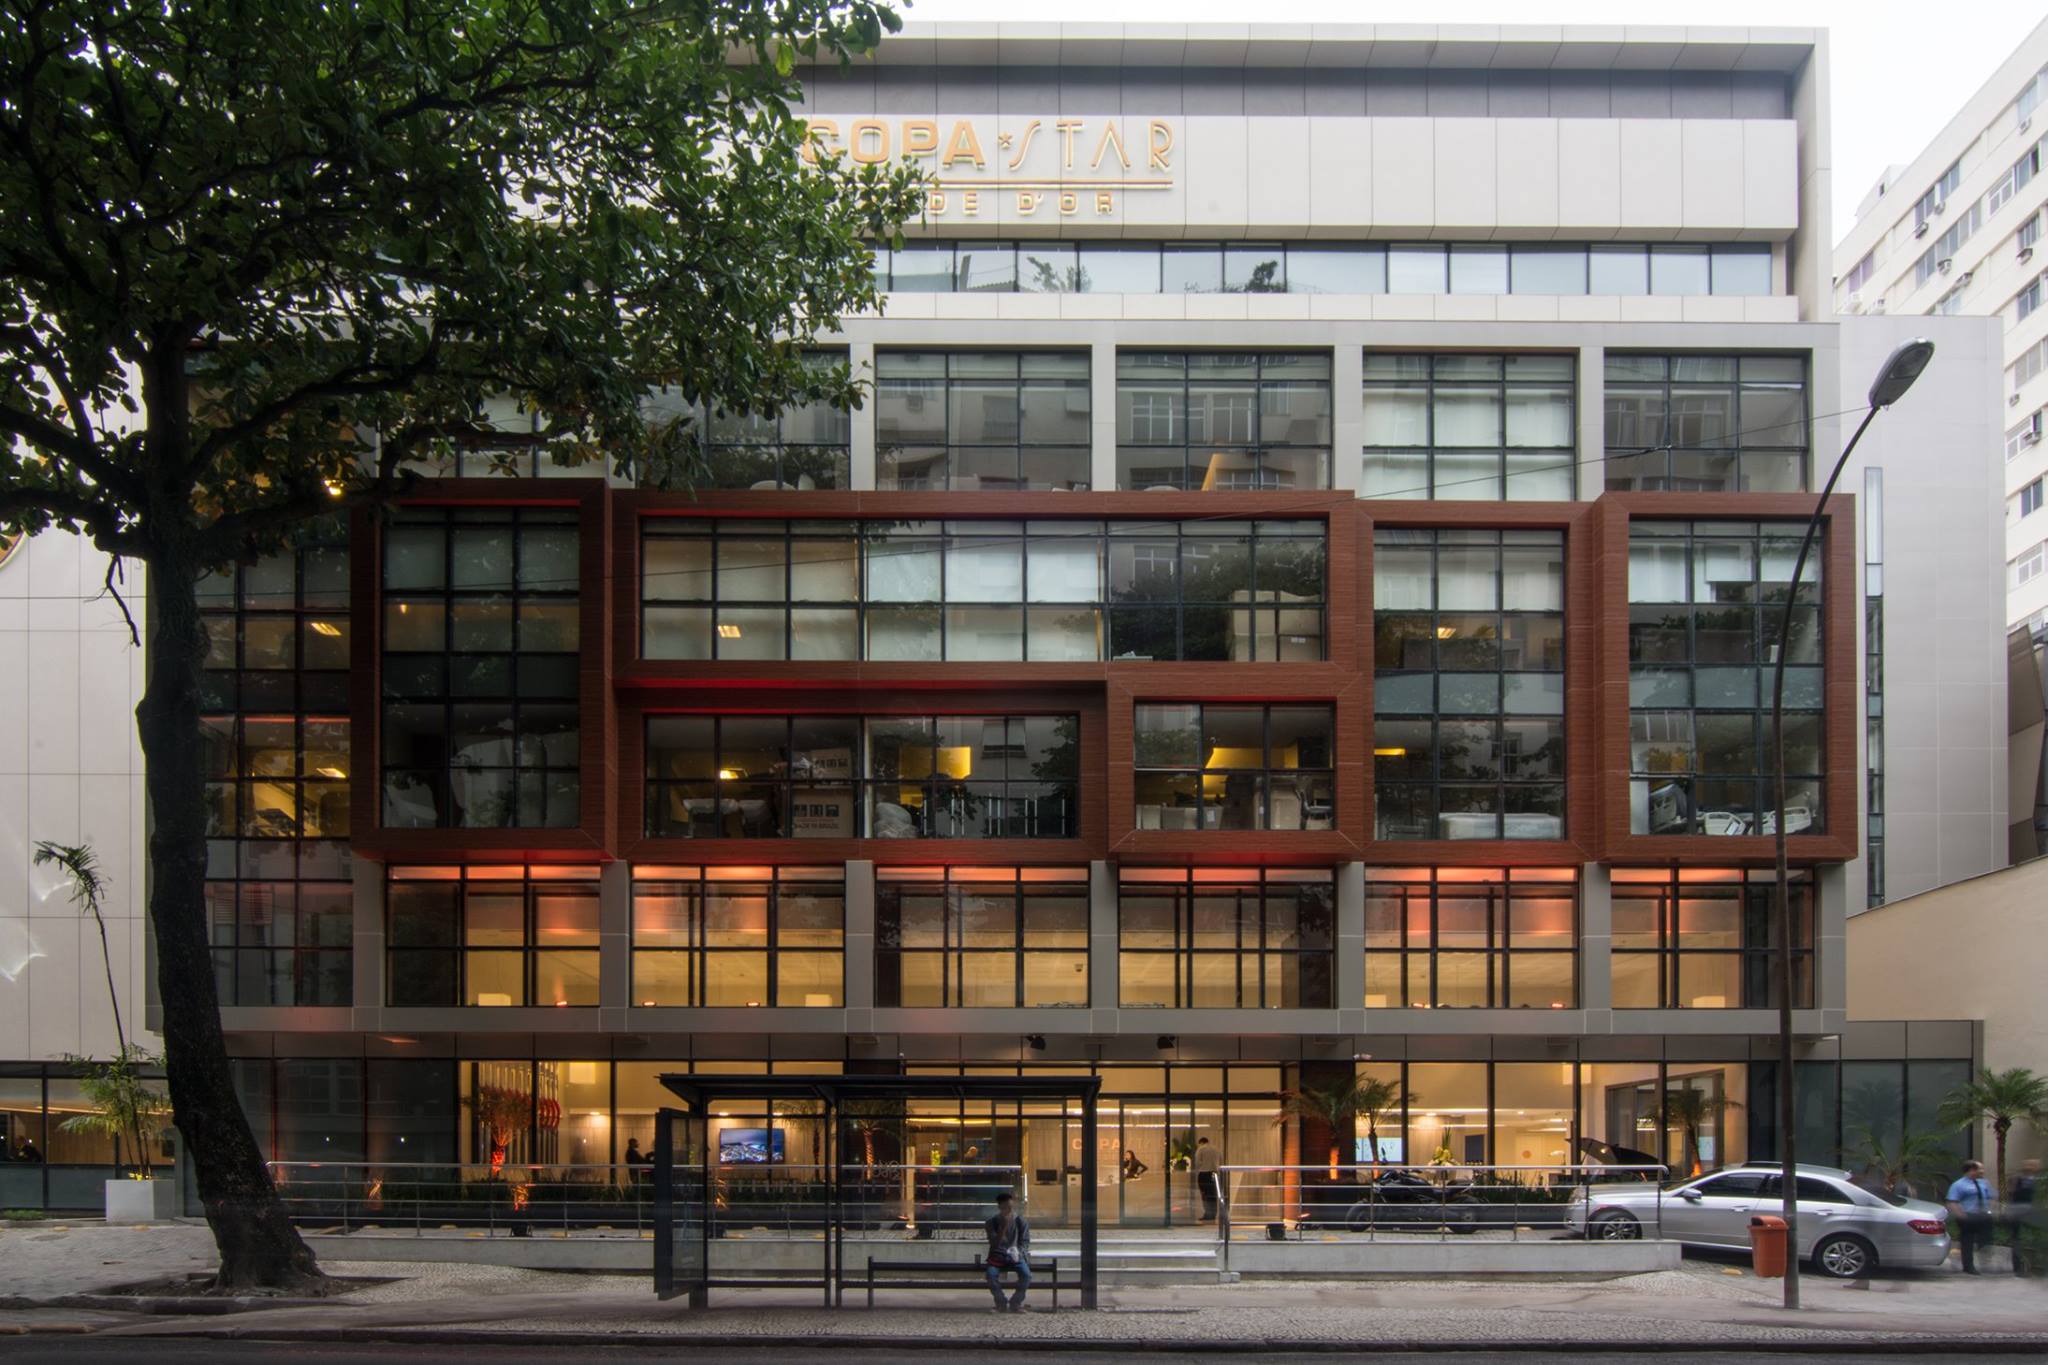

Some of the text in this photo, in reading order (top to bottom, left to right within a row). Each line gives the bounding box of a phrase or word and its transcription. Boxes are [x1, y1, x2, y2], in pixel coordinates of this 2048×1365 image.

[802, 119, 1173, 168] COPA STAR
[1018, 191, 1112, 213] D'OR
[1071, 1138, 1120, 1150] CPA
